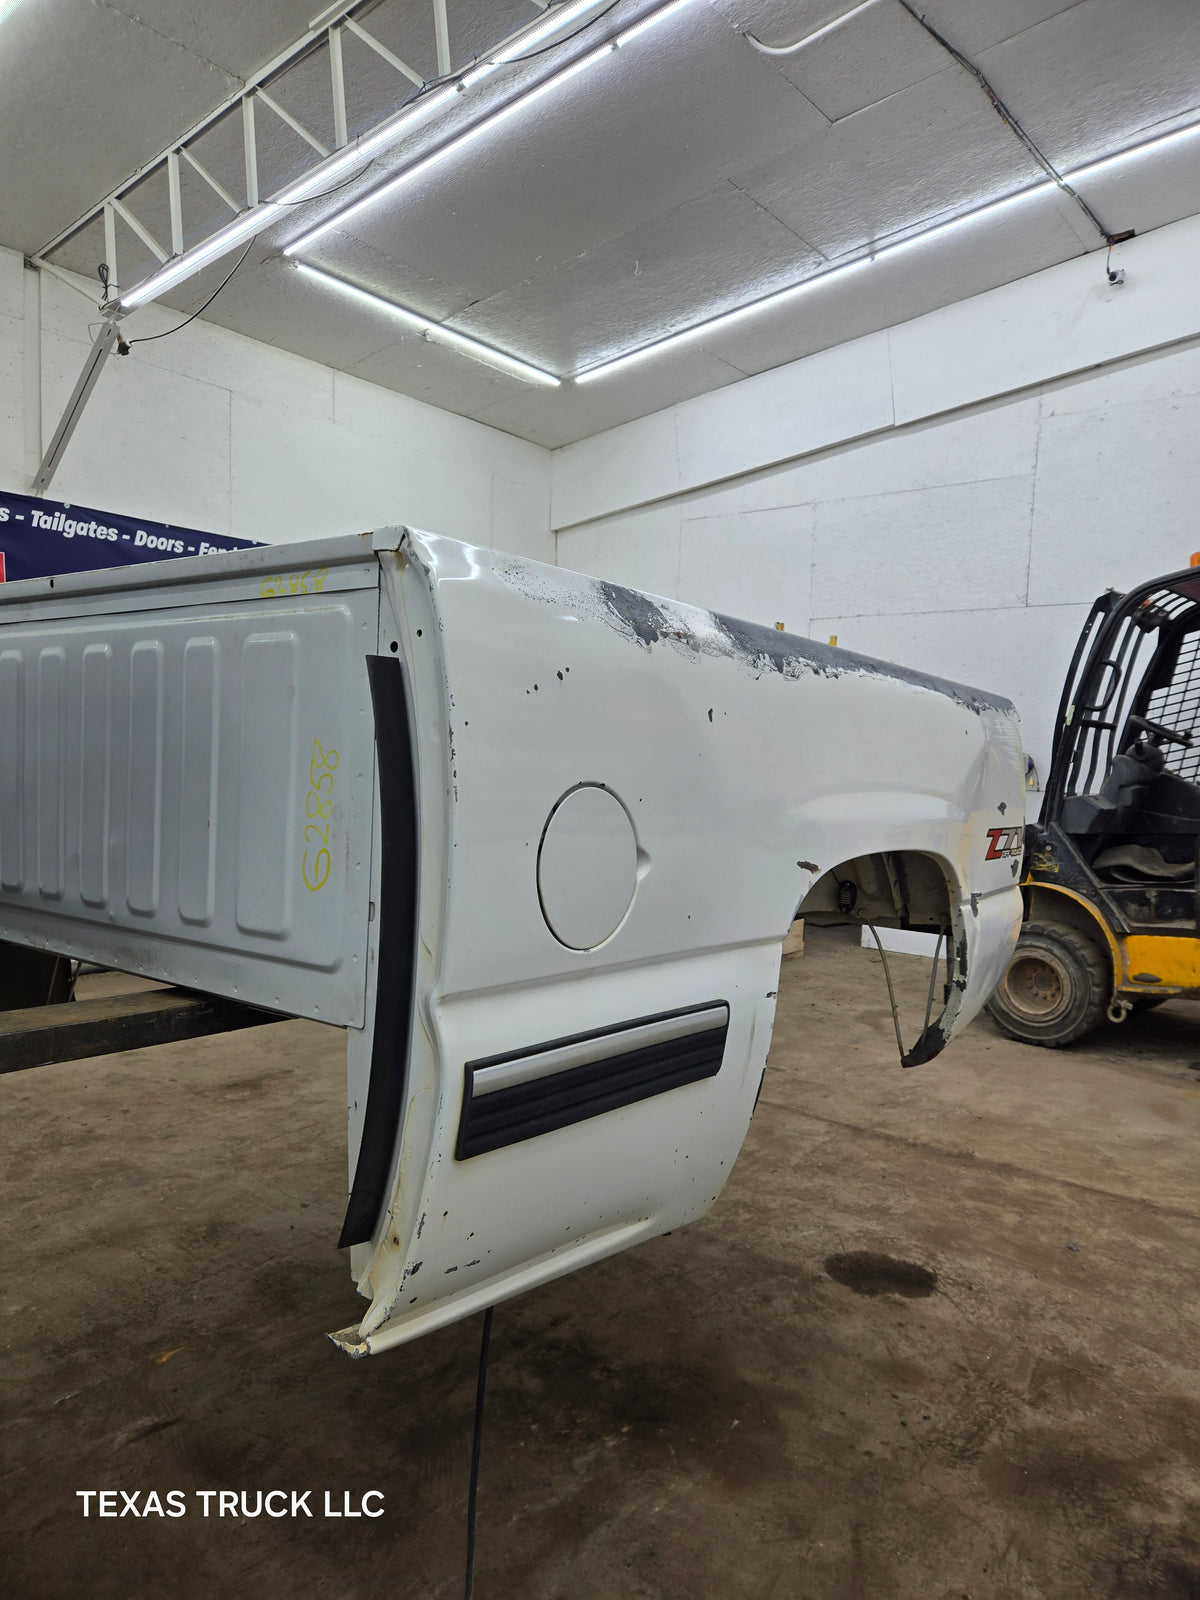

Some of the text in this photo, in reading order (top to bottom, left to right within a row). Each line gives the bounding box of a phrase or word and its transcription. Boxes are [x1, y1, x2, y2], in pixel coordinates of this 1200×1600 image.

[31, 509, 119, 541] Tailgates
[134, 530, 185, 553] Doors
[985, 826, 1023, 861] Z71
